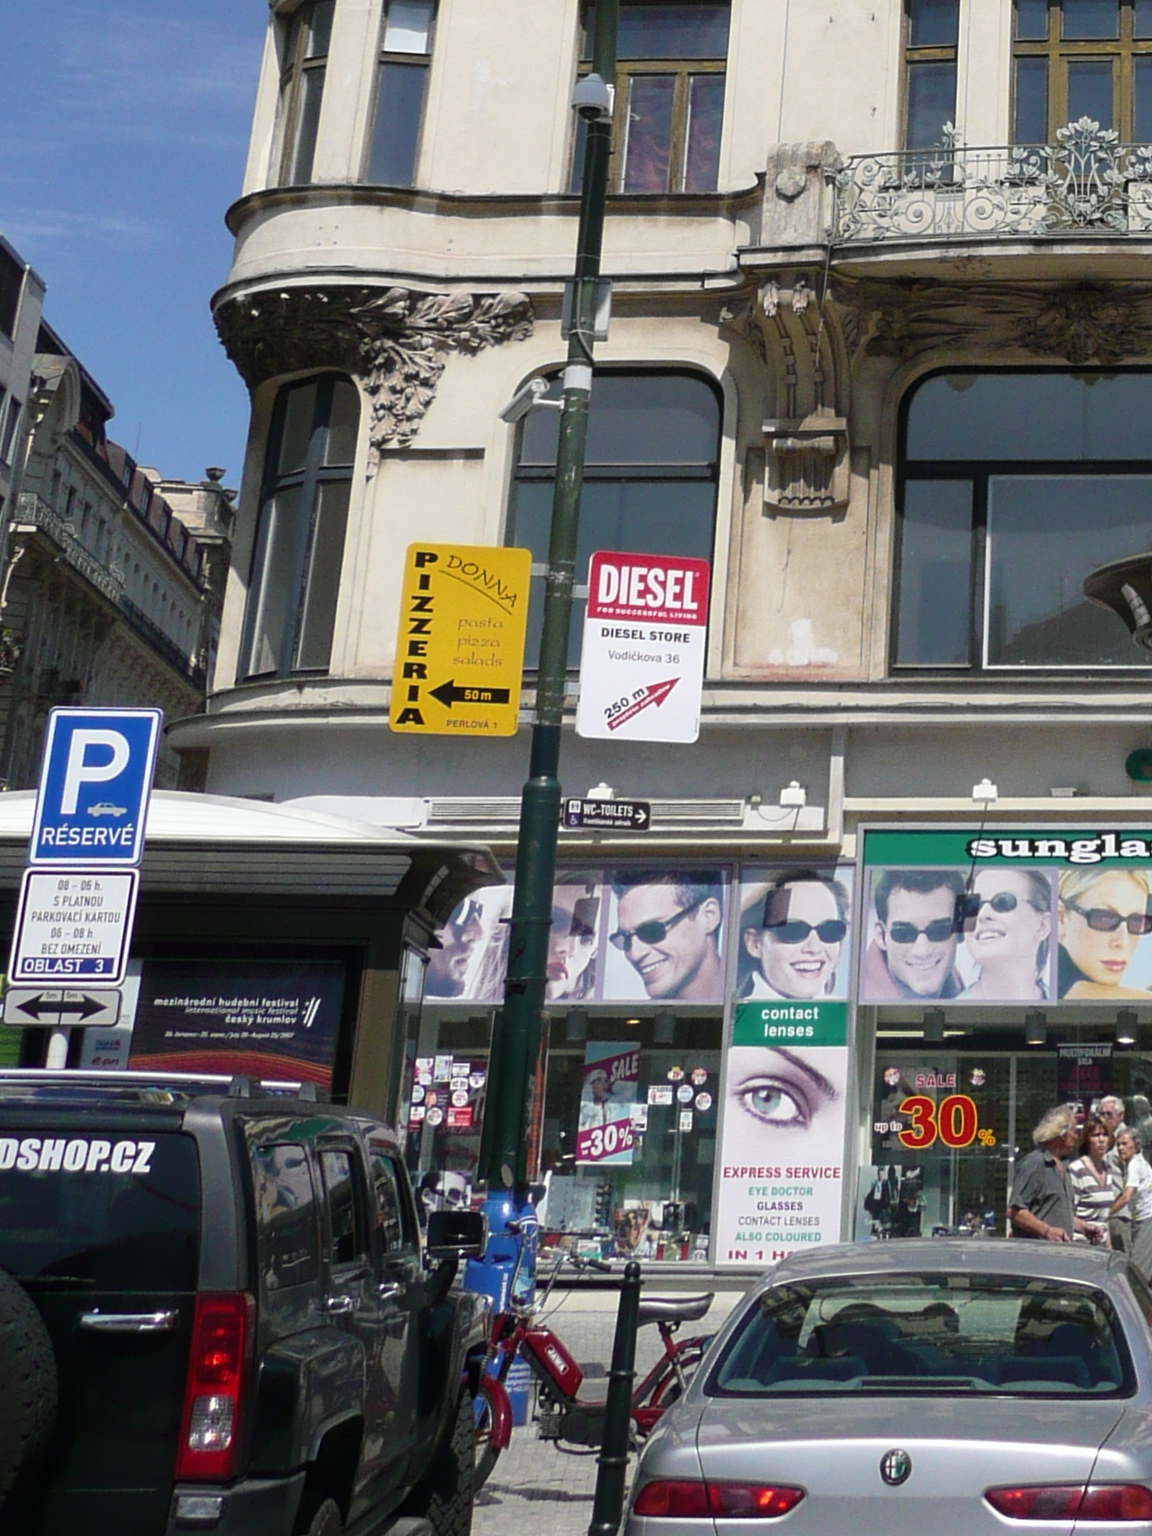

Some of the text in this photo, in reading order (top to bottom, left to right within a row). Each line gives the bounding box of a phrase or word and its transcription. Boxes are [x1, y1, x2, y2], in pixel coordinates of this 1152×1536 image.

[447, 554, 517, 608] DONNA
[598, 564, 698, 610] DIESEL
[458, 616, 503, 631] pasta
[395, 551, 438, 726] PIZZERIA
[601, 627, 691, 643] DIESEL STORE
[457, 635, 500, 649] pizza
[453, 652, 502, 667] salads
[608, 650, 680, 664] Vodičkova 36
[464, 689, 492, 701] 50 m
[603, 687, 646, 719] 250 m
[446, 718, 489, 729] PERLOVÁ
[60, 729, 130, 814] P
[41, 823, 134, 846] RÉSERVÉ
[58, 879, 70, 891] 08
[53, 895, 104, 907] S PLATNOU
[31, 909, 120, 923] PARKOVACÍ KARTOU
[74, 927, 85, 939] 08
[41, 942, 102, 955] BEZ OMEZENÍ
[24, 959, 104, 973] OBLAST 3
[262, 997, 299, 1007] festival
[257, 1014, 297, 1024] krumlov
[762, 1007, 819, 1019] contact
[764, 1024, 814, 1037] lenses
[610, 1053, 639, 1082] SALE
[916, 1073, 956, 1088] SALE
[874, 1122, 889, 1133] up
[890, 1120, 903, 1132] to
[723, 1167, 841, 1178] EXPRESS SERVICE
[748, 1186, 813, 1196] EYE DOCTOR
[757, 1201, 803, 1211] GLASSES
[738, 1216, 820, 1226] CONTACT LENSES
[735, 1232, 822, 1242] ALSO COLOURED
[728, 1250, 747, 1260] IN
[755, 1251, 763, 1260] 1
